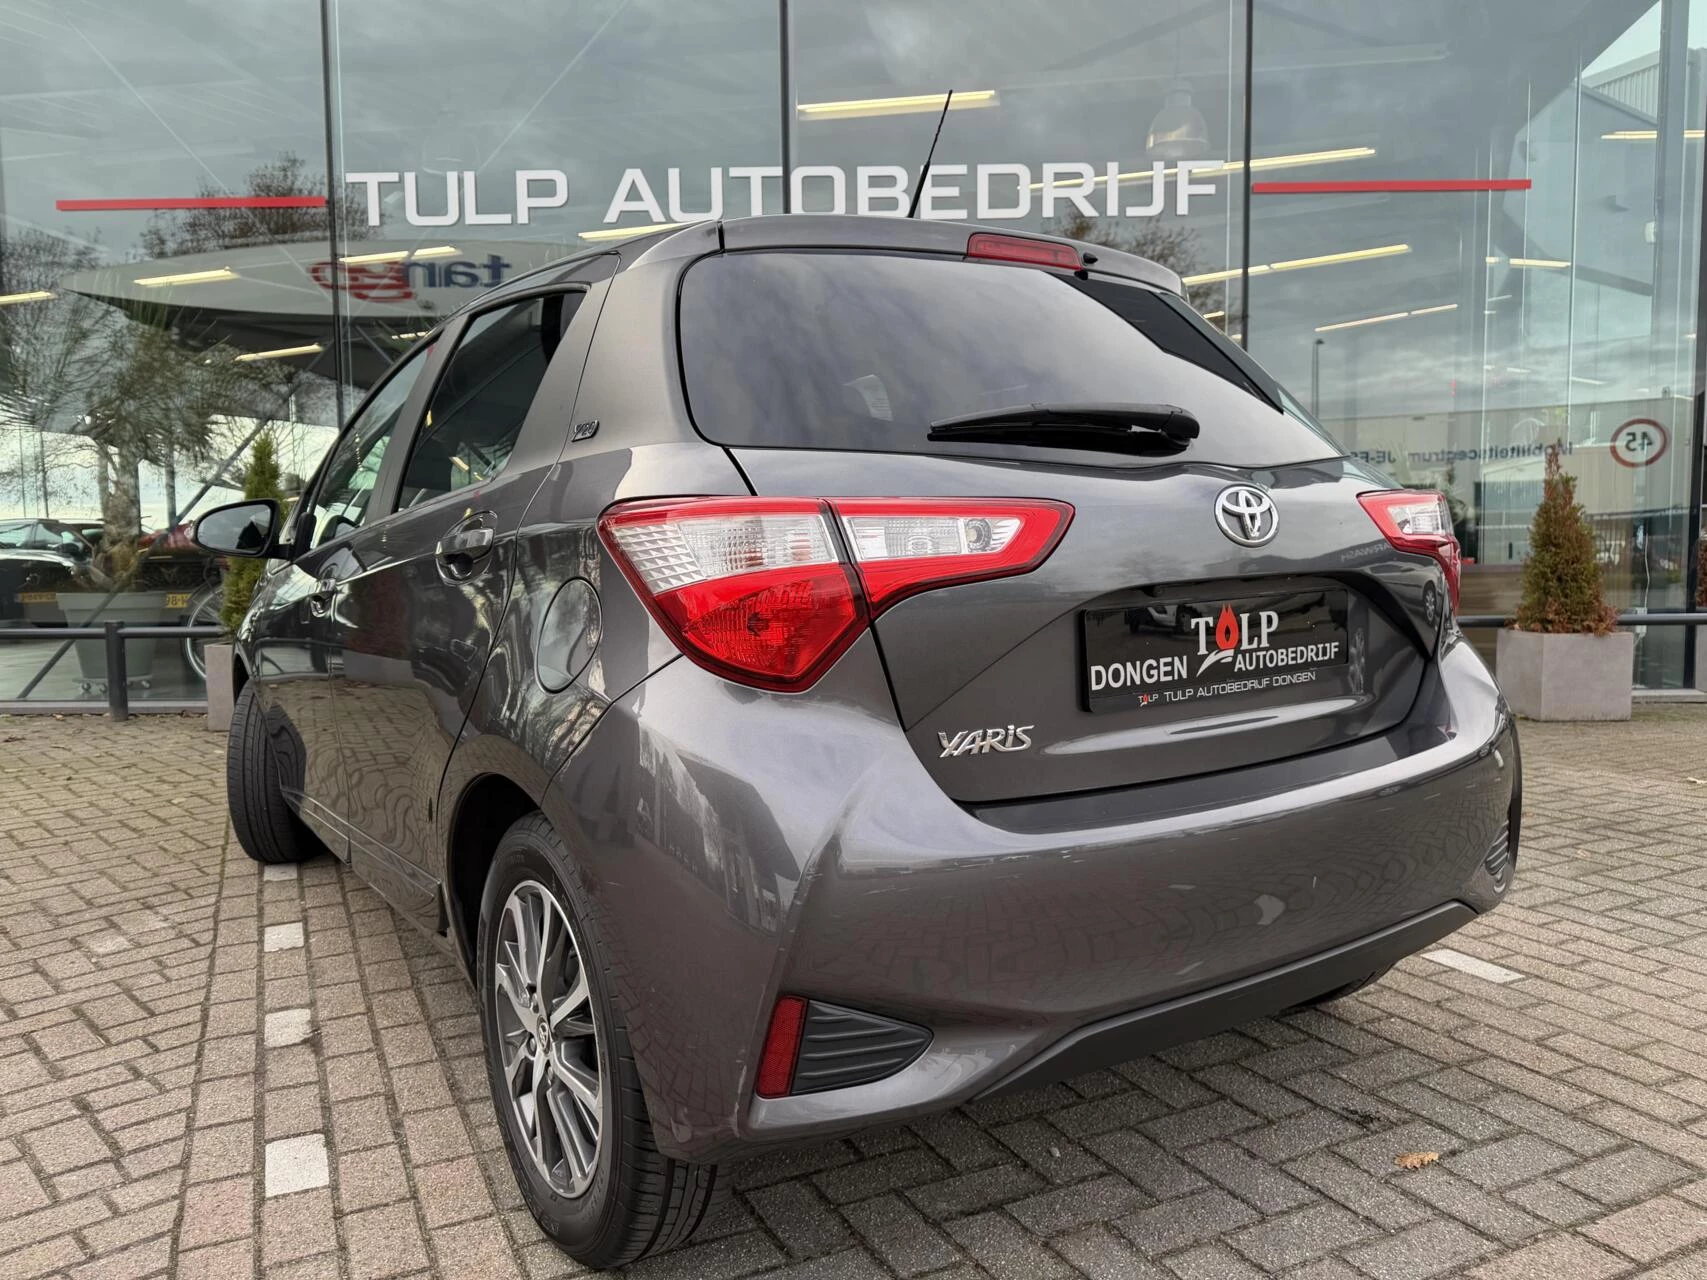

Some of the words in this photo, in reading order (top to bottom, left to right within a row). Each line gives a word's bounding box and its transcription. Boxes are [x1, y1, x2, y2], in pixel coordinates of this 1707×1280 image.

[345, 169, 568, 227] TULP
[602, 160, 1224, 224] AUTOBEDRIJF
[1090, 655, 1188, 691] DONGEN
[1234, 642, 1340, 672] AUTOBEDRIJF
[1163, 688, 1194, 702] TULP
[1196, 677, 1270, 698] AUTOBEDRIJF
[1272, 671, 1316, 687] DONGEN
